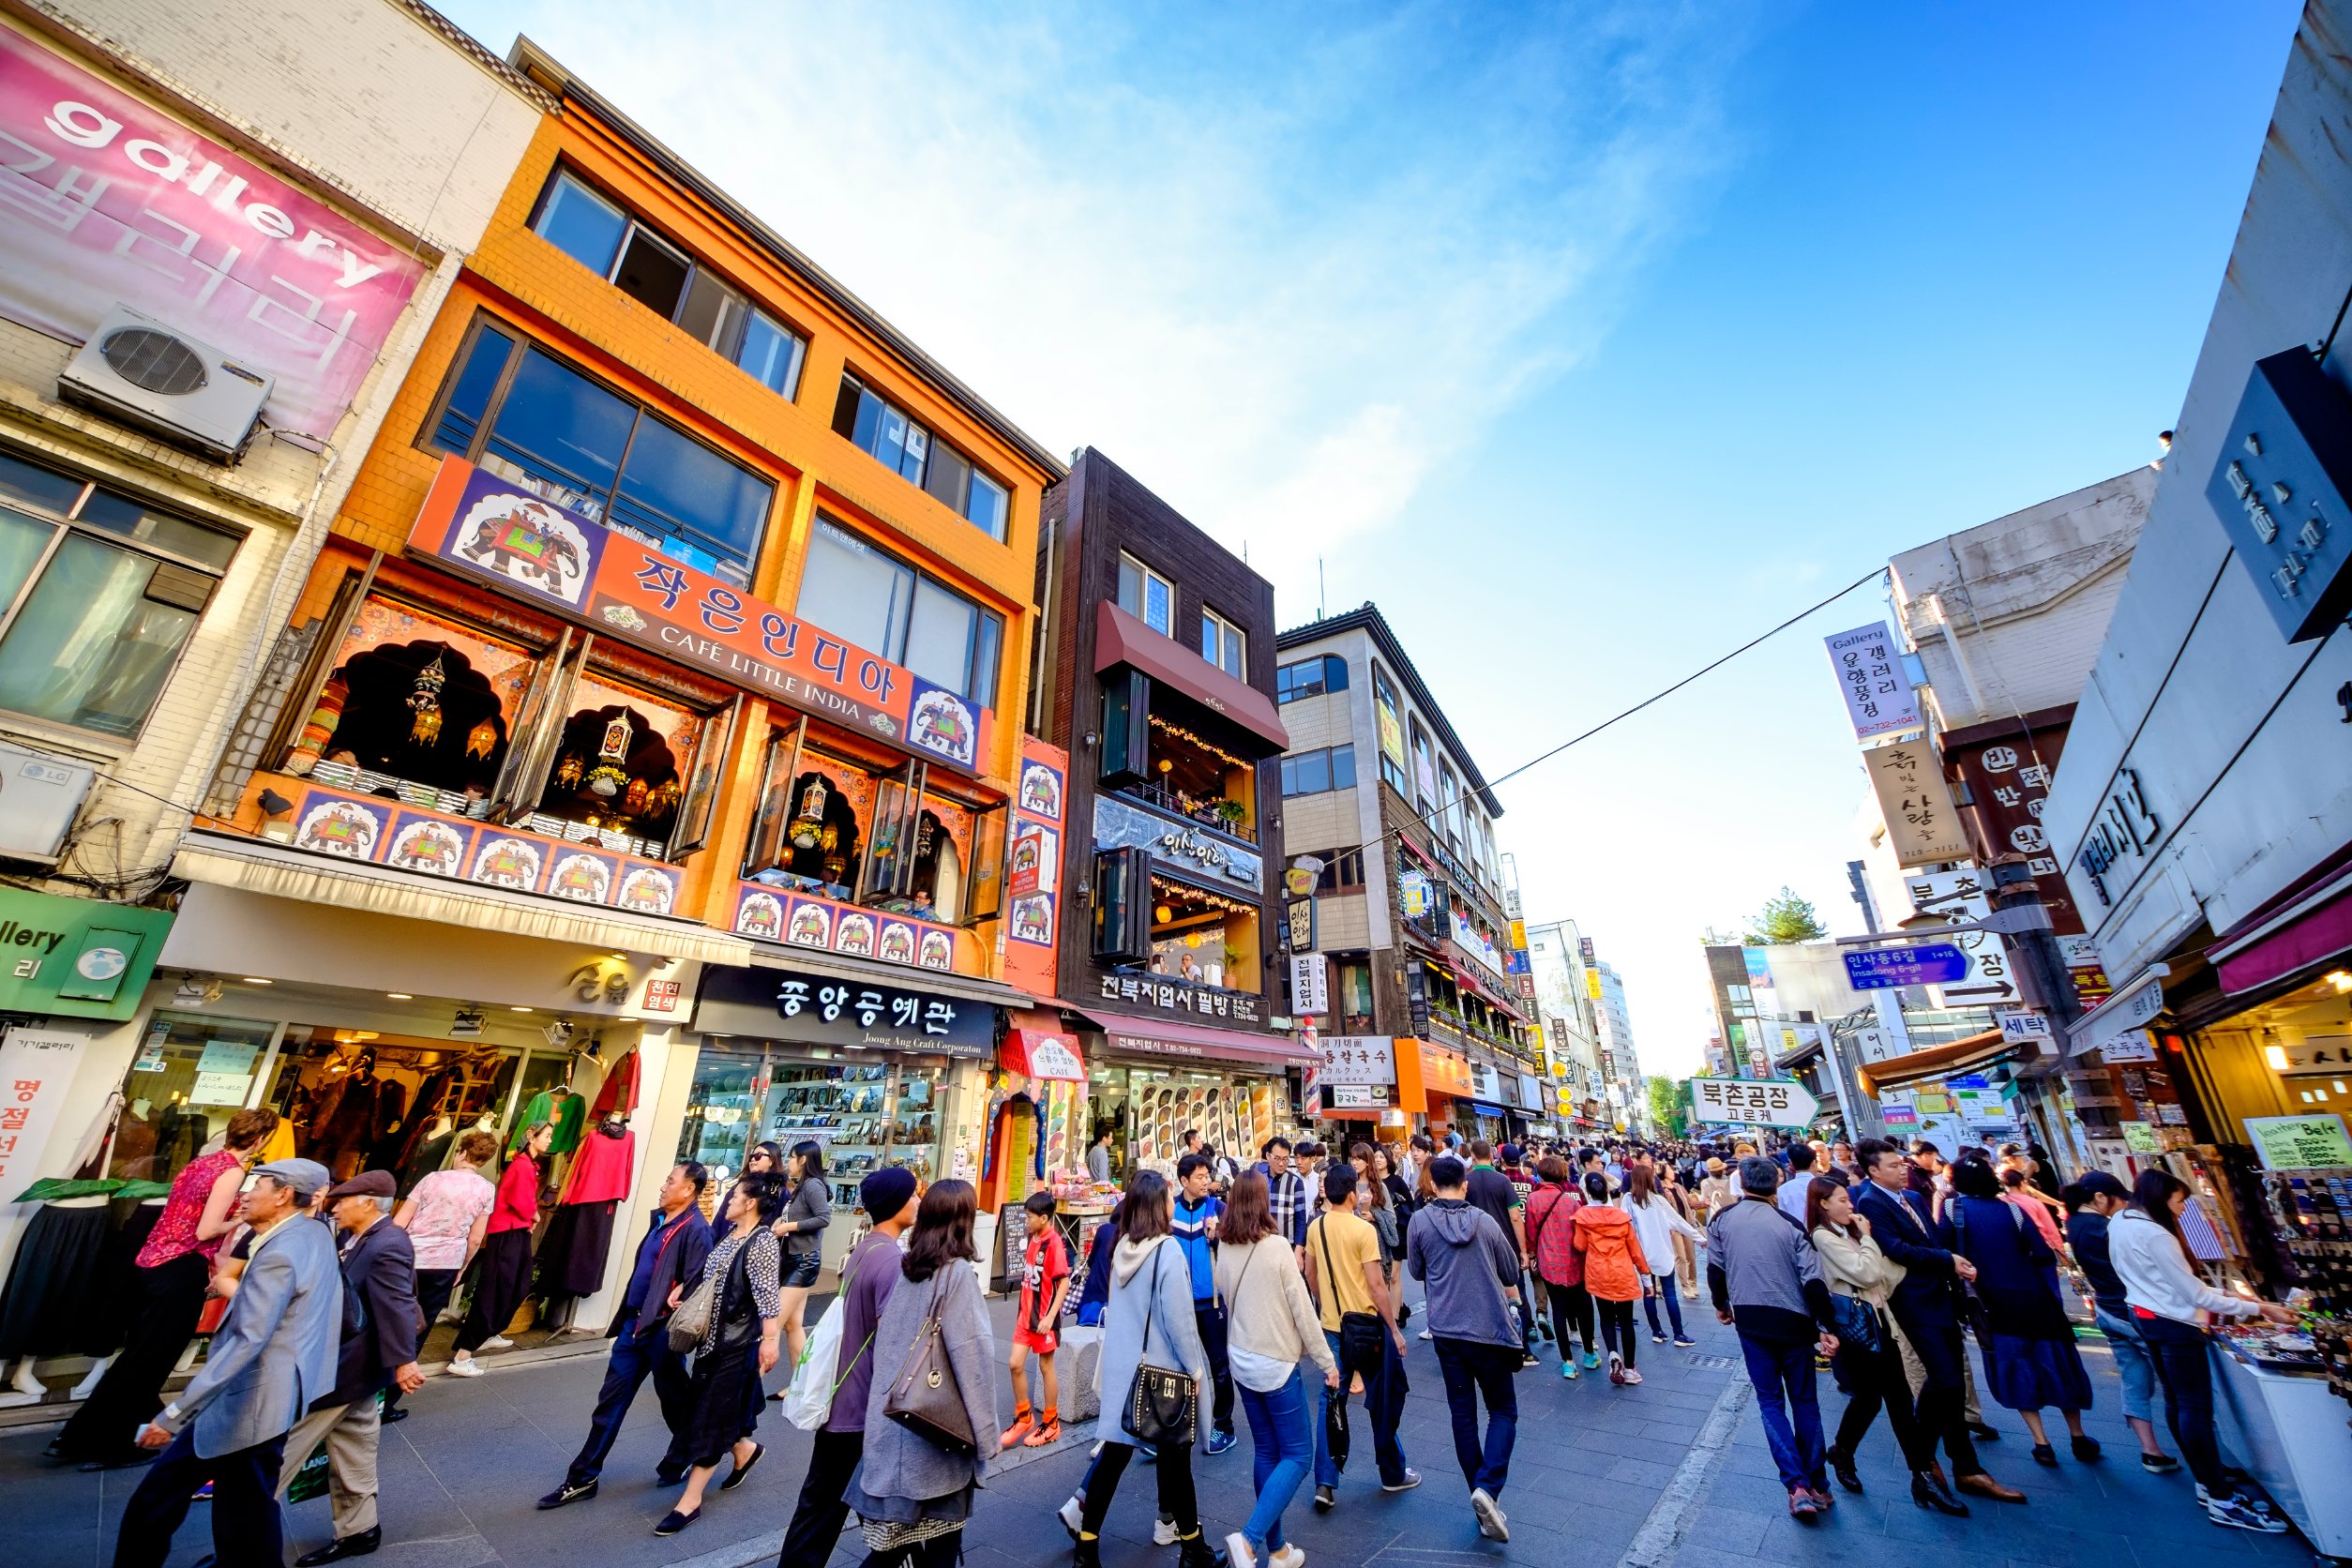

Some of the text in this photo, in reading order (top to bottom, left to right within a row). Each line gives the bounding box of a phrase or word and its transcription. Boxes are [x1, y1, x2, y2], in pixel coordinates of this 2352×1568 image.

[44, 100, 383, 289] gallery
[0, 131, 356, 379] 갤러리
[633, 553, 897, 704] 작은인디아
[1833, 630, 1883, 649] Gallery
[660, 626, 859, 719] CAFÉ LITTLE INDIA
[1864, 644, 1897, 694] 갤러리
[1858, 716, 1917, 733] 02-732-1041
[46, 770, 67, 781] LG
[1847, 950, 1917, 968] 인사동6길
[13, 959, 41, 980] 리
[1851, 964, 1922, 978] Insadong 6-gil
[652, 981, 677, 995] 천연
[1298, 959, 1314, 1009] 전북지업사
[649, 995, 675, 1011] 염색
[1101, 975, 1229, 1017] 전북지업사 필방
[776, 981, 956, 1034] 중앙공예관
[2005, 1017, 2044, 1033] 세탁
[18, 1039, 74, 1051] 기기갤러리
[863, 1033, 891, 1045] Joong
[893, 1034, 912, 1049] Ang
[912, 1037, 935, 1049] Craft
[1118, 1036, 1160, 1050] 전북지업사
[2104, 1041, 2146, 1054] 순두부
[1703, 1083, 1788, 1109] 북촌공장
[1726, 1108, 1772, 1123] 고로케
[2300, 1123, 2337, 1136] Belt
